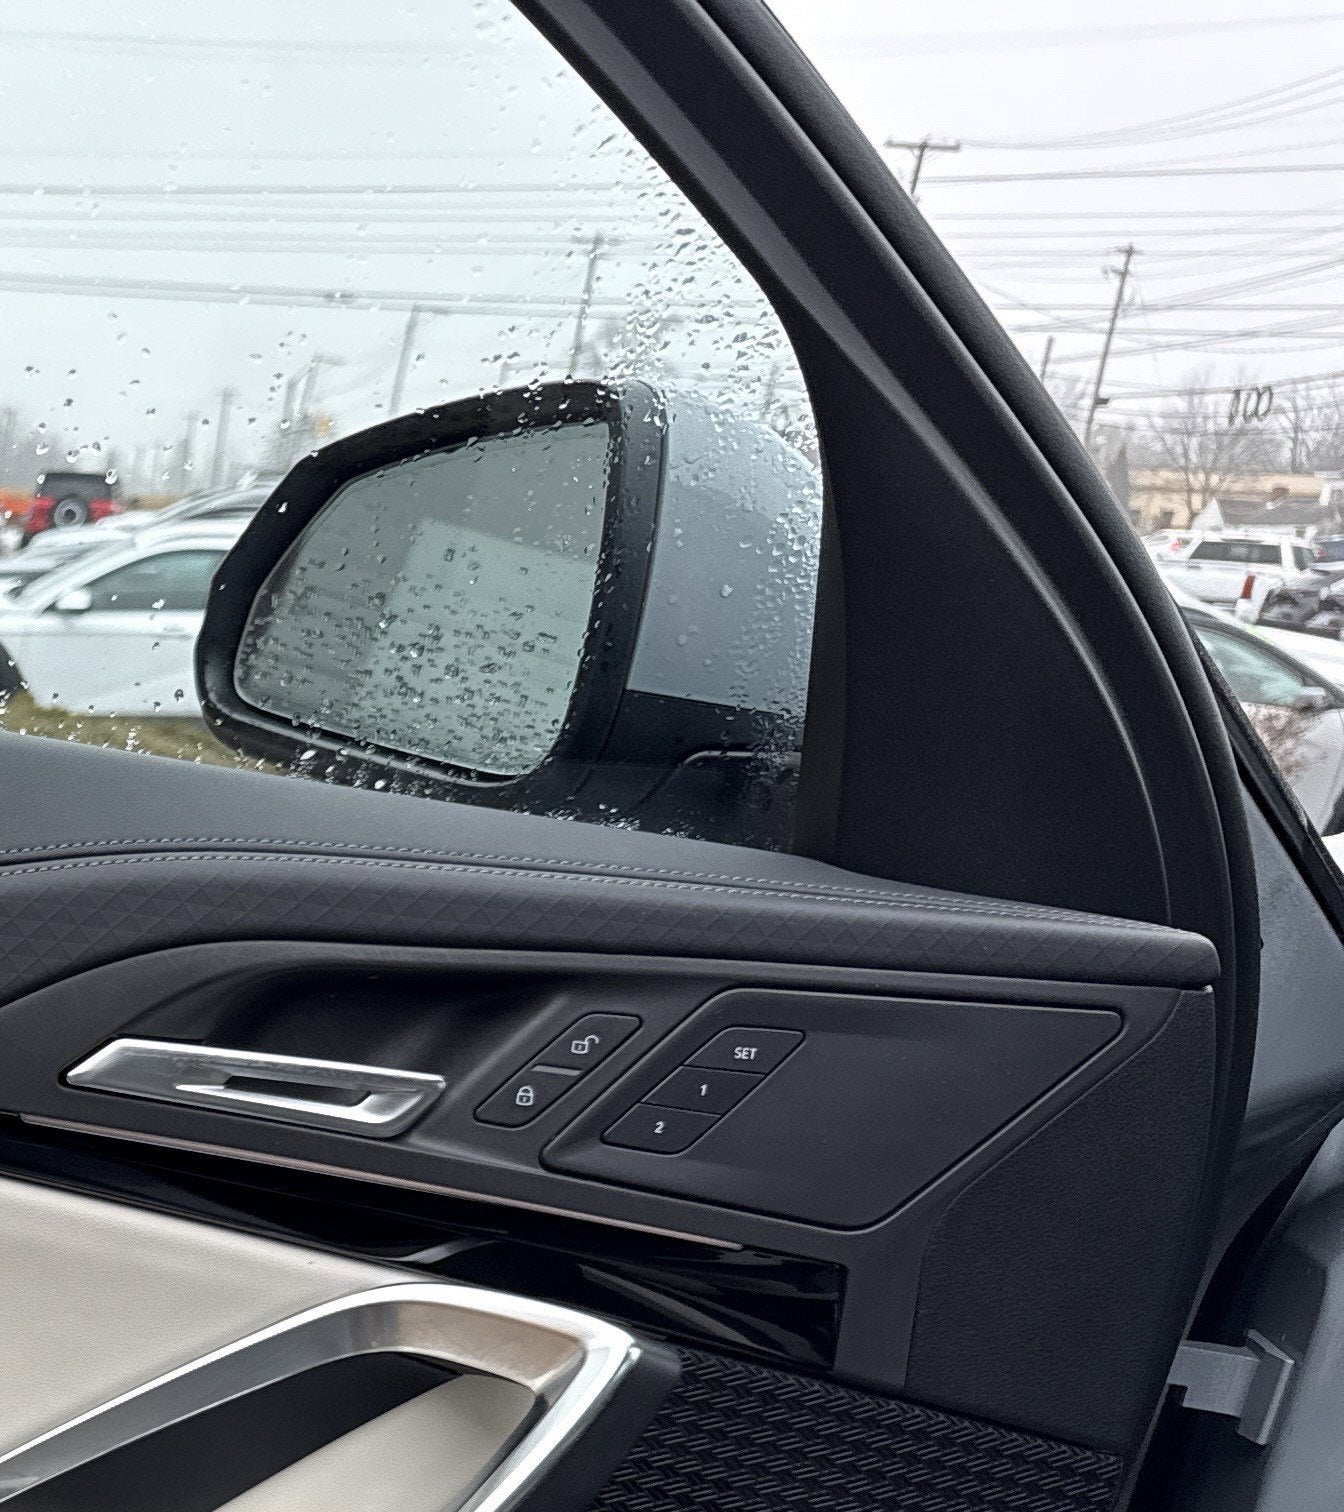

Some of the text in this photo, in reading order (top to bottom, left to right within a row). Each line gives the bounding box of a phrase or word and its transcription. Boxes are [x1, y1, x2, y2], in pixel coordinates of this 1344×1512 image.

[733, 1046, 758, 1060] SET
[699, 1083, 709, 1097] 1
[653, 1120, 665, 1134] 2
